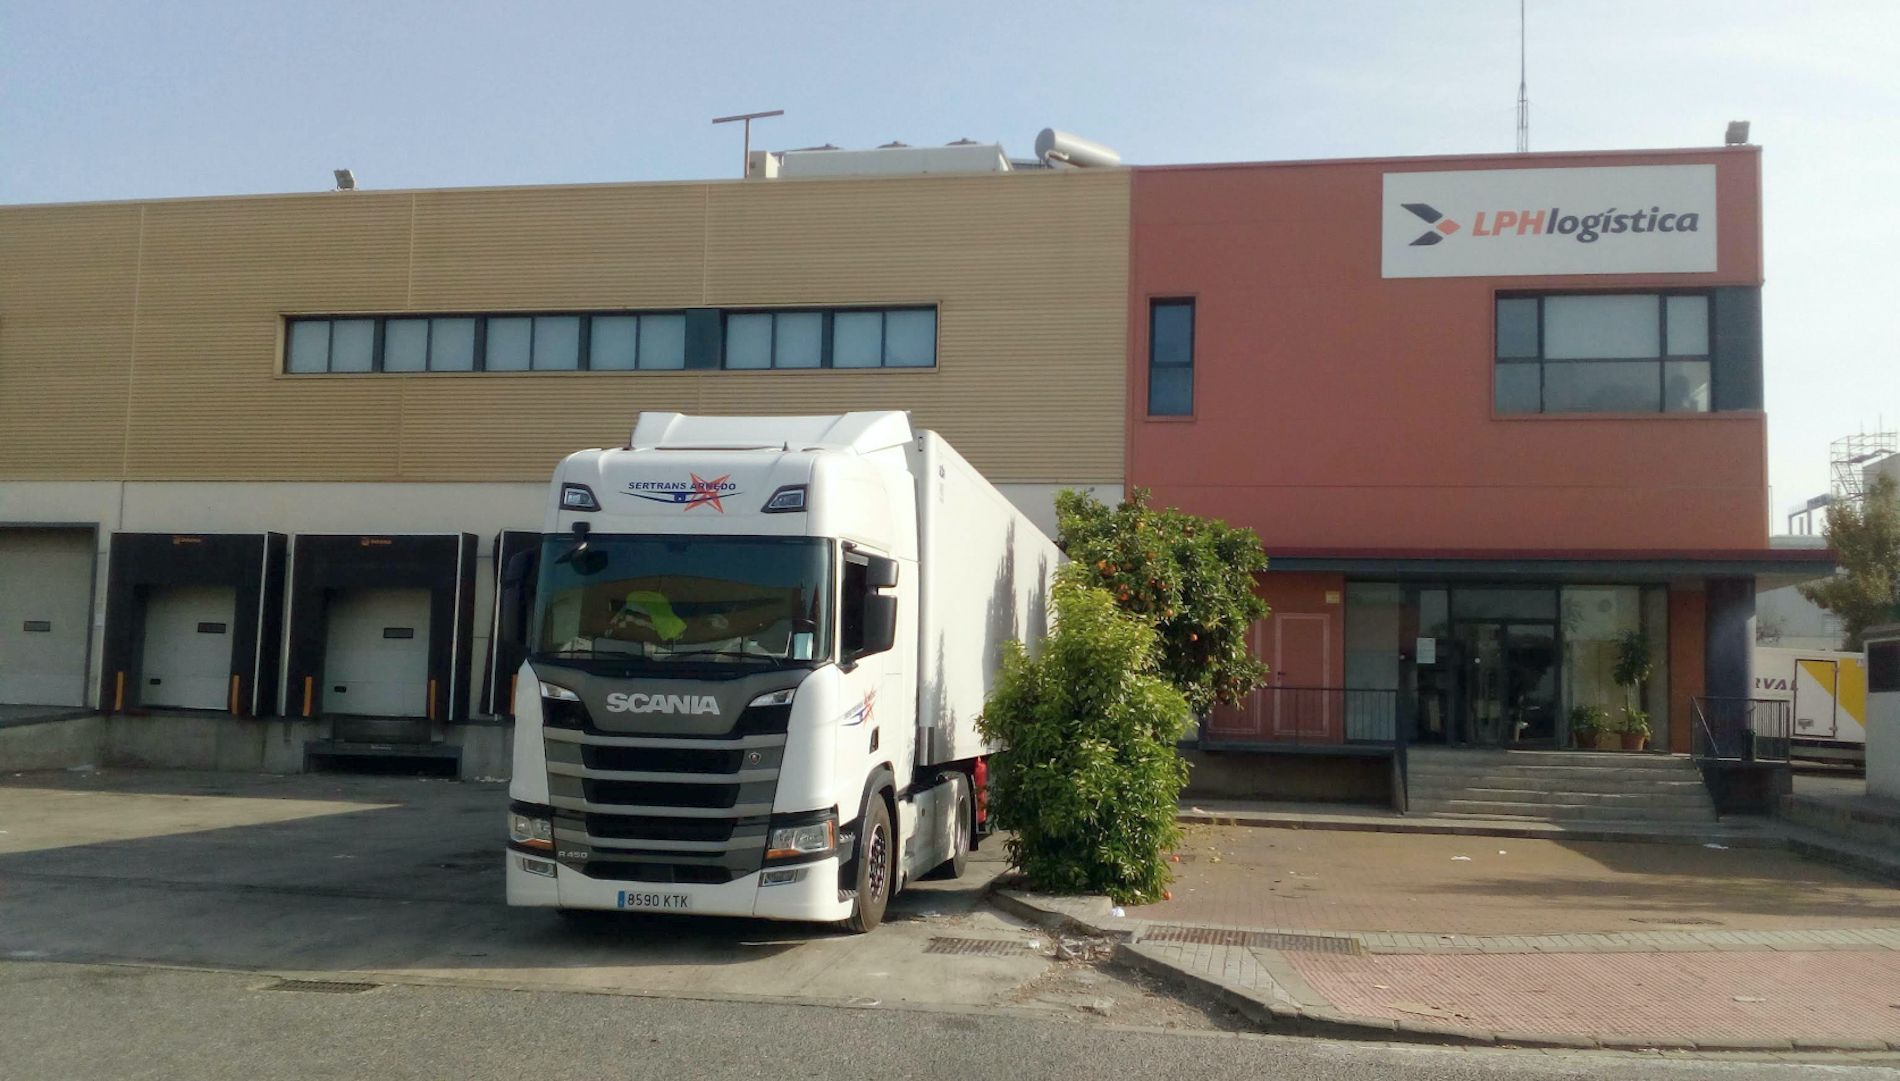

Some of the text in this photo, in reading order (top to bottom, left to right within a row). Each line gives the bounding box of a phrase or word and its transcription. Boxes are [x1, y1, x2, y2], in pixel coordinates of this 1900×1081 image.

[628, 481, 737, 491] SERTRANS ARNEDO
[606, 692, 721, 715] SCANIA
[567, 851, 588, 859] 450
[627, 894, 688, 908] 8590 KTK
